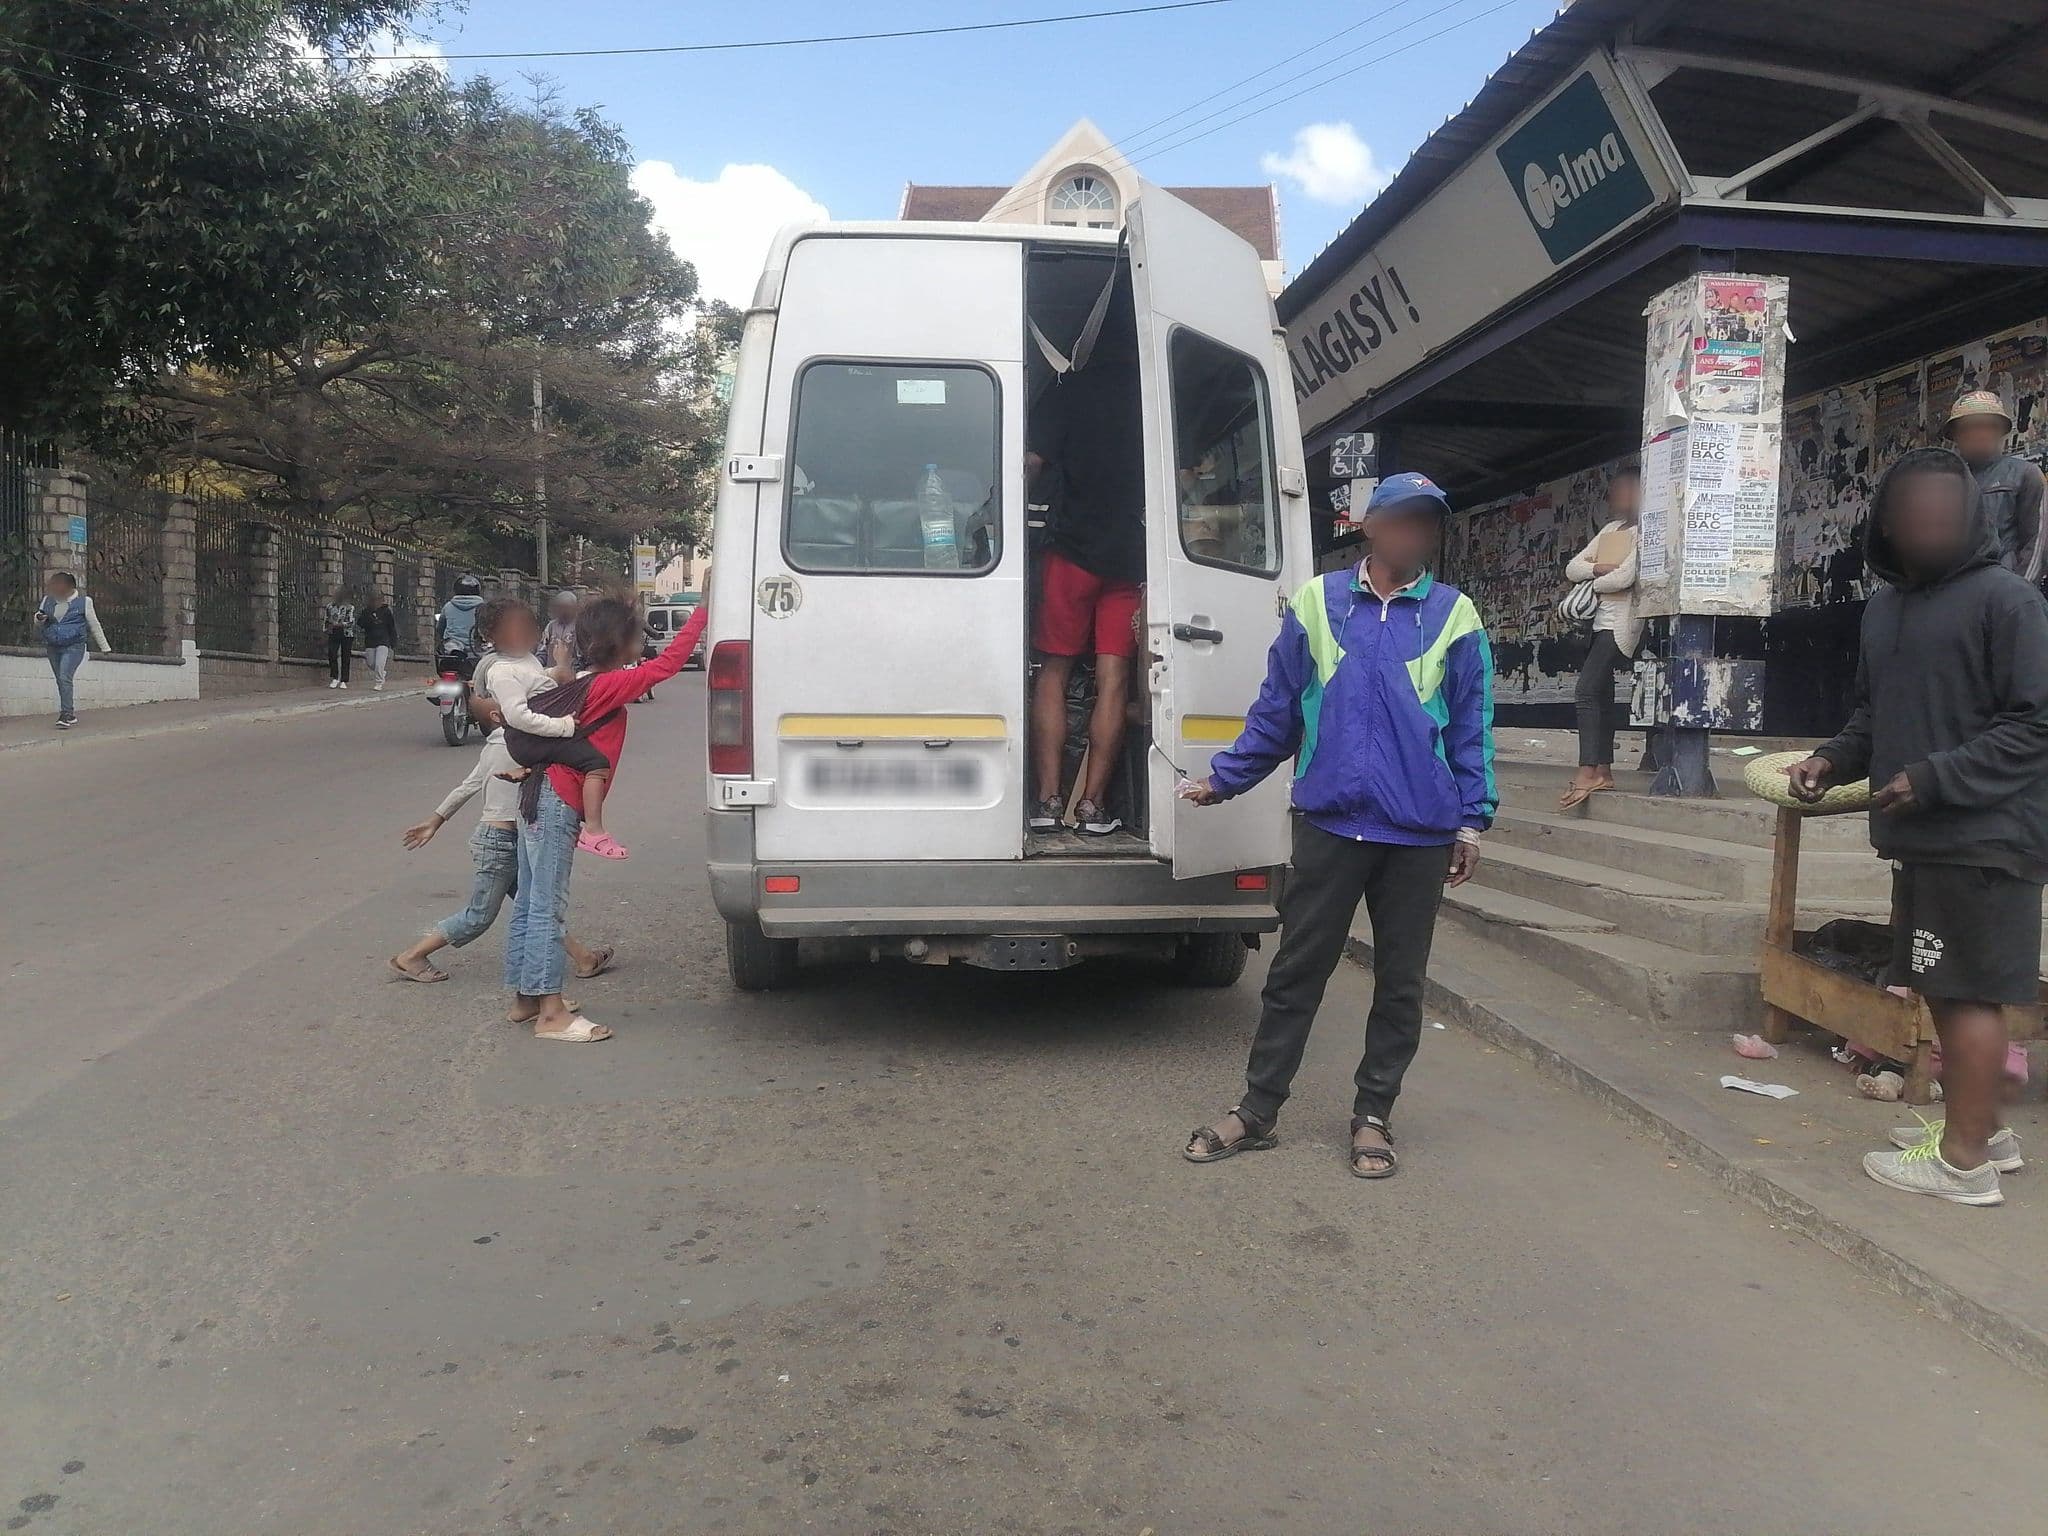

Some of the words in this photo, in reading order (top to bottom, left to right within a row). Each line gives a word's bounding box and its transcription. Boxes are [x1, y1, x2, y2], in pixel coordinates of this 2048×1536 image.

[1692, 441, 1725, 451] BEPC
[1691, 450, 1725, 460] BAC
[1687, 512, 1721, 521] BEPC
[1687, 520, 1721, 529] BAC
[765, 582, 794, 612] 75
